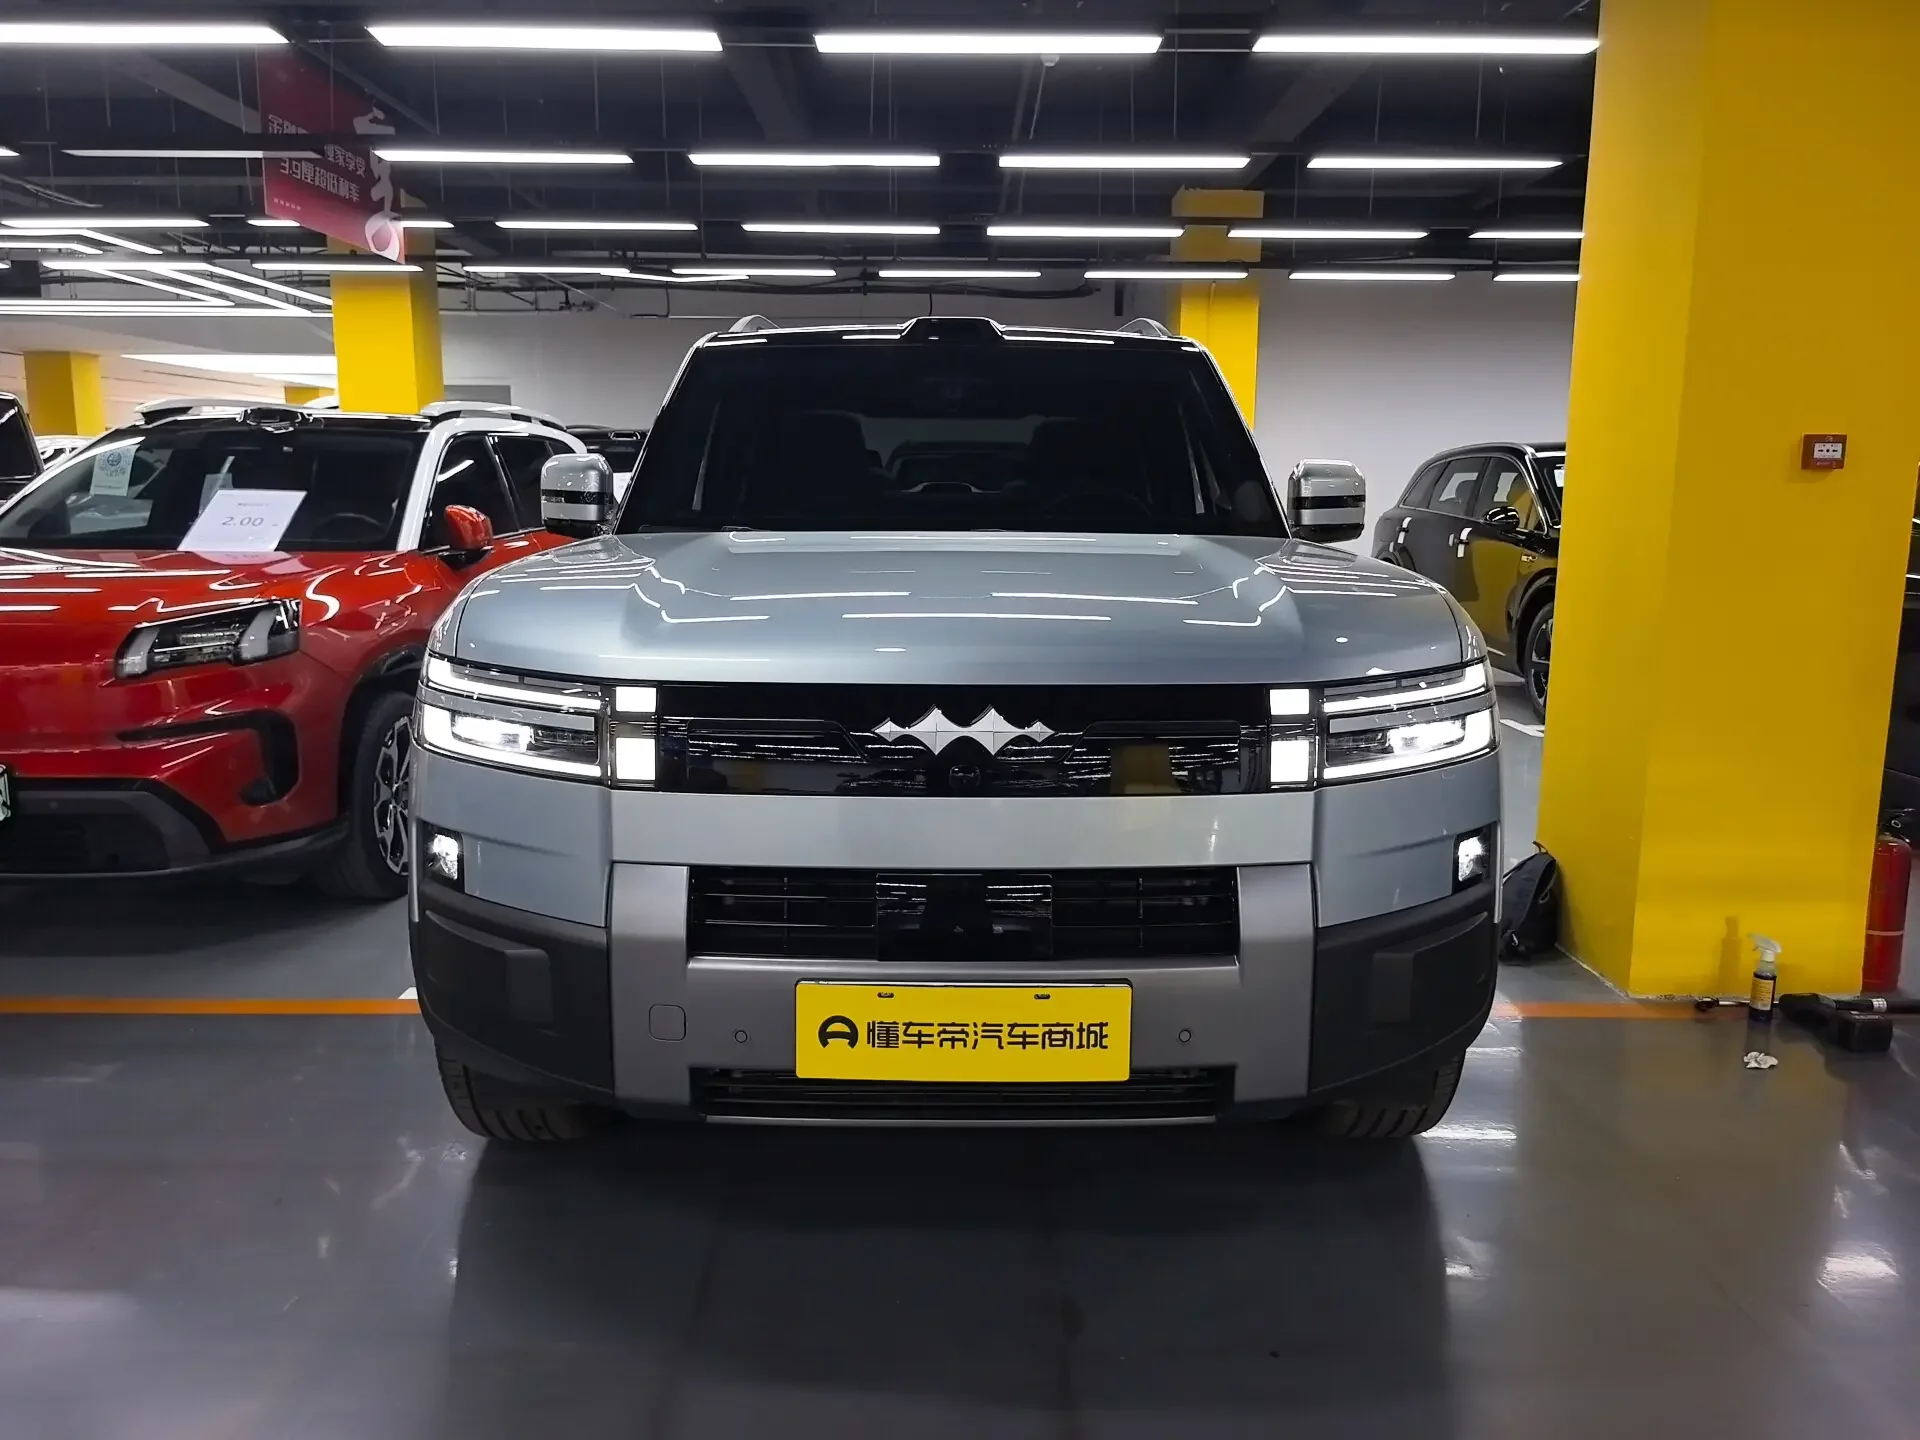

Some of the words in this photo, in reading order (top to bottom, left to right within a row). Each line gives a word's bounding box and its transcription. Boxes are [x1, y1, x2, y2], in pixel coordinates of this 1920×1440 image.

[221, 516, 264, 527] 2.00
[866, 1020, 1109, 1050] 懂车帝汽车商城
